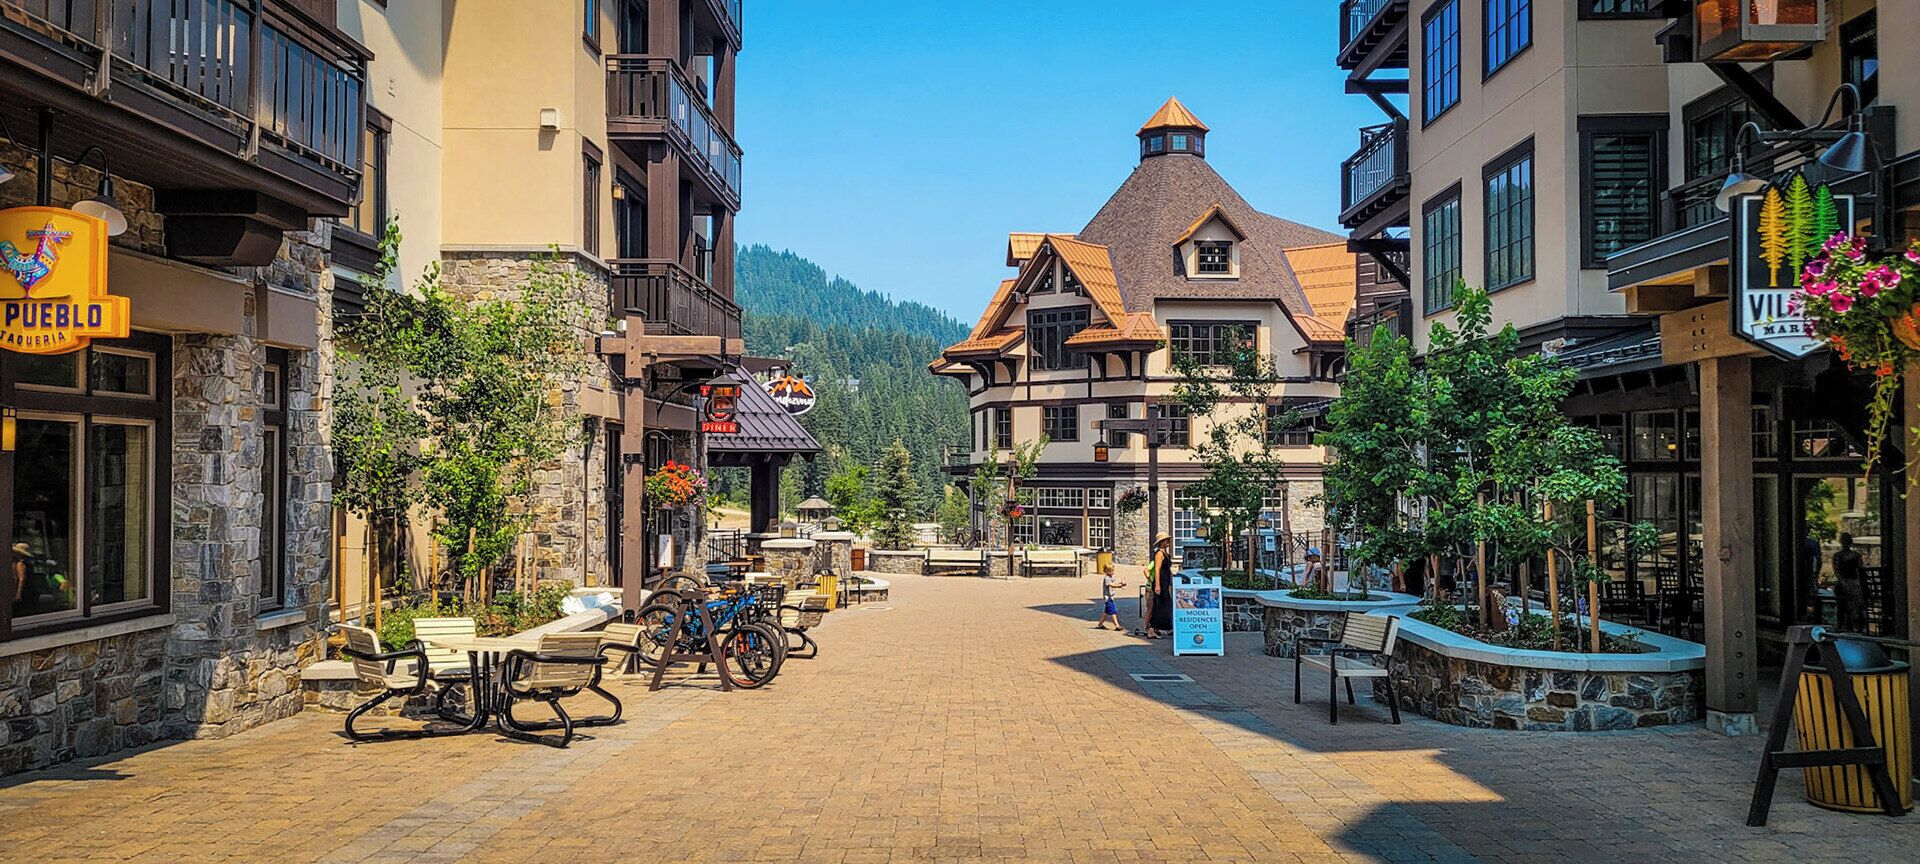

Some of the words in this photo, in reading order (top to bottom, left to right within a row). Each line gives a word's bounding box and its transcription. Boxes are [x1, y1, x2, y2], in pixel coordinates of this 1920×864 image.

[5, 303, 102, 328] PUEBLO
[0, 330, 66, 346] TAQUERIA
[701, 421, 737, 433] DINER
